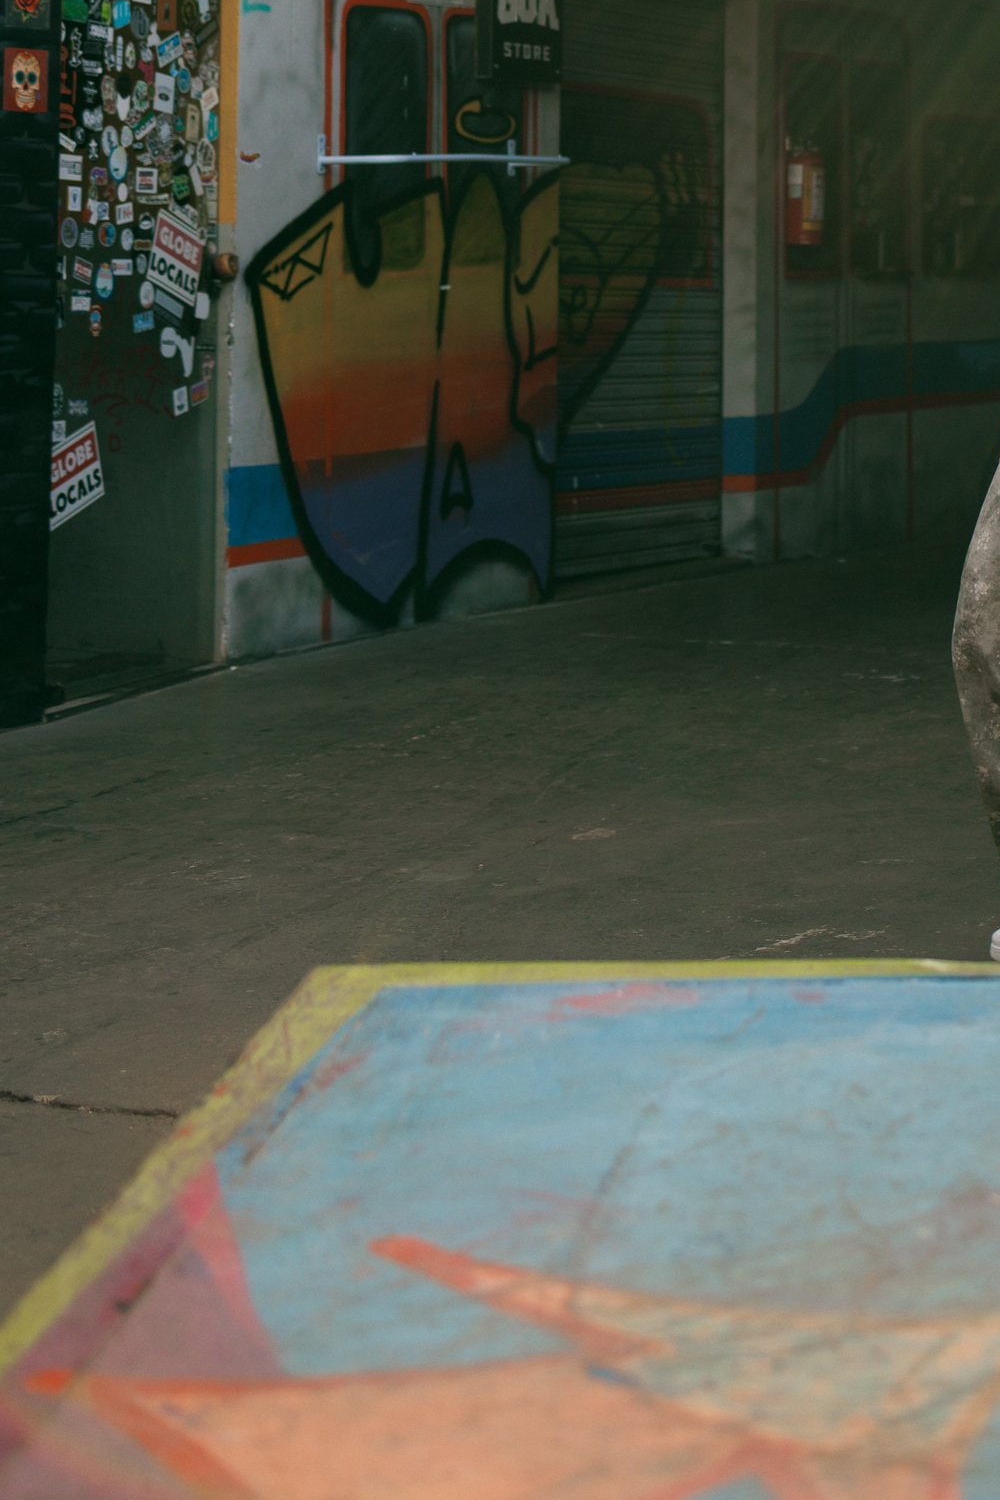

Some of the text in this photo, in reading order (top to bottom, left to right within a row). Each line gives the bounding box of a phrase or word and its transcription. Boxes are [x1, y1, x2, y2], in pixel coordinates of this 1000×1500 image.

[503, 41, 551, 62] STORE
[159, 225, 200, 265] GLOBE
[150, 253, 197, 295] LOCALS
[51, 440, 95, 483] GLOBE
[50, 468, 102, 519] LOCALS
